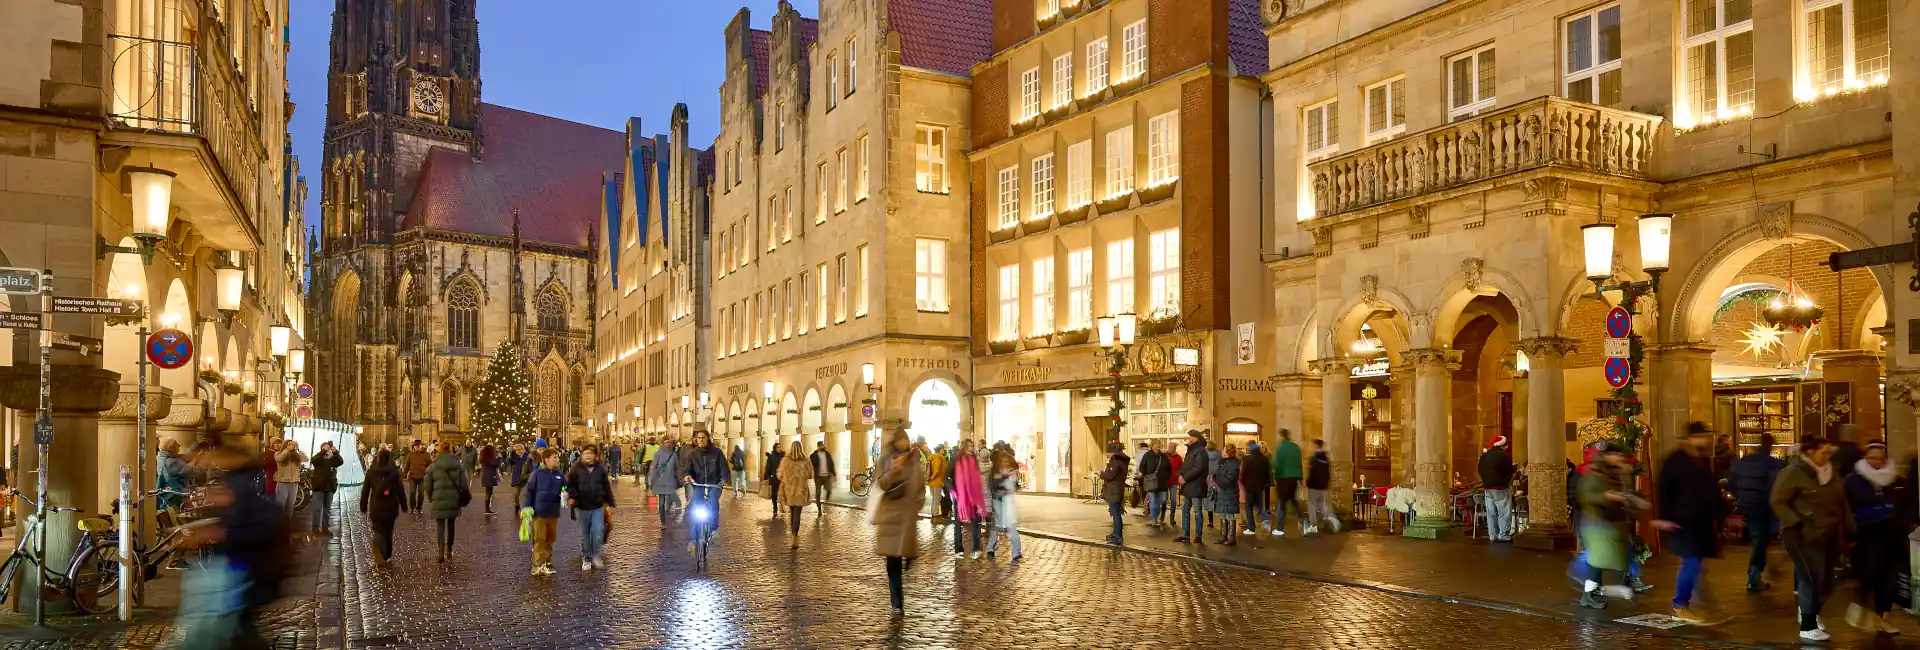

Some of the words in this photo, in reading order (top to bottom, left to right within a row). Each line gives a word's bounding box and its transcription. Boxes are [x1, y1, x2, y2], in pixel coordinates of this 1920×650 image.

[815, 361, 848, 380] PETZHOLD
[896, 357, 960, 370] PETZHOLD
[1002, 366, 1051, 384] WEITKAMP
